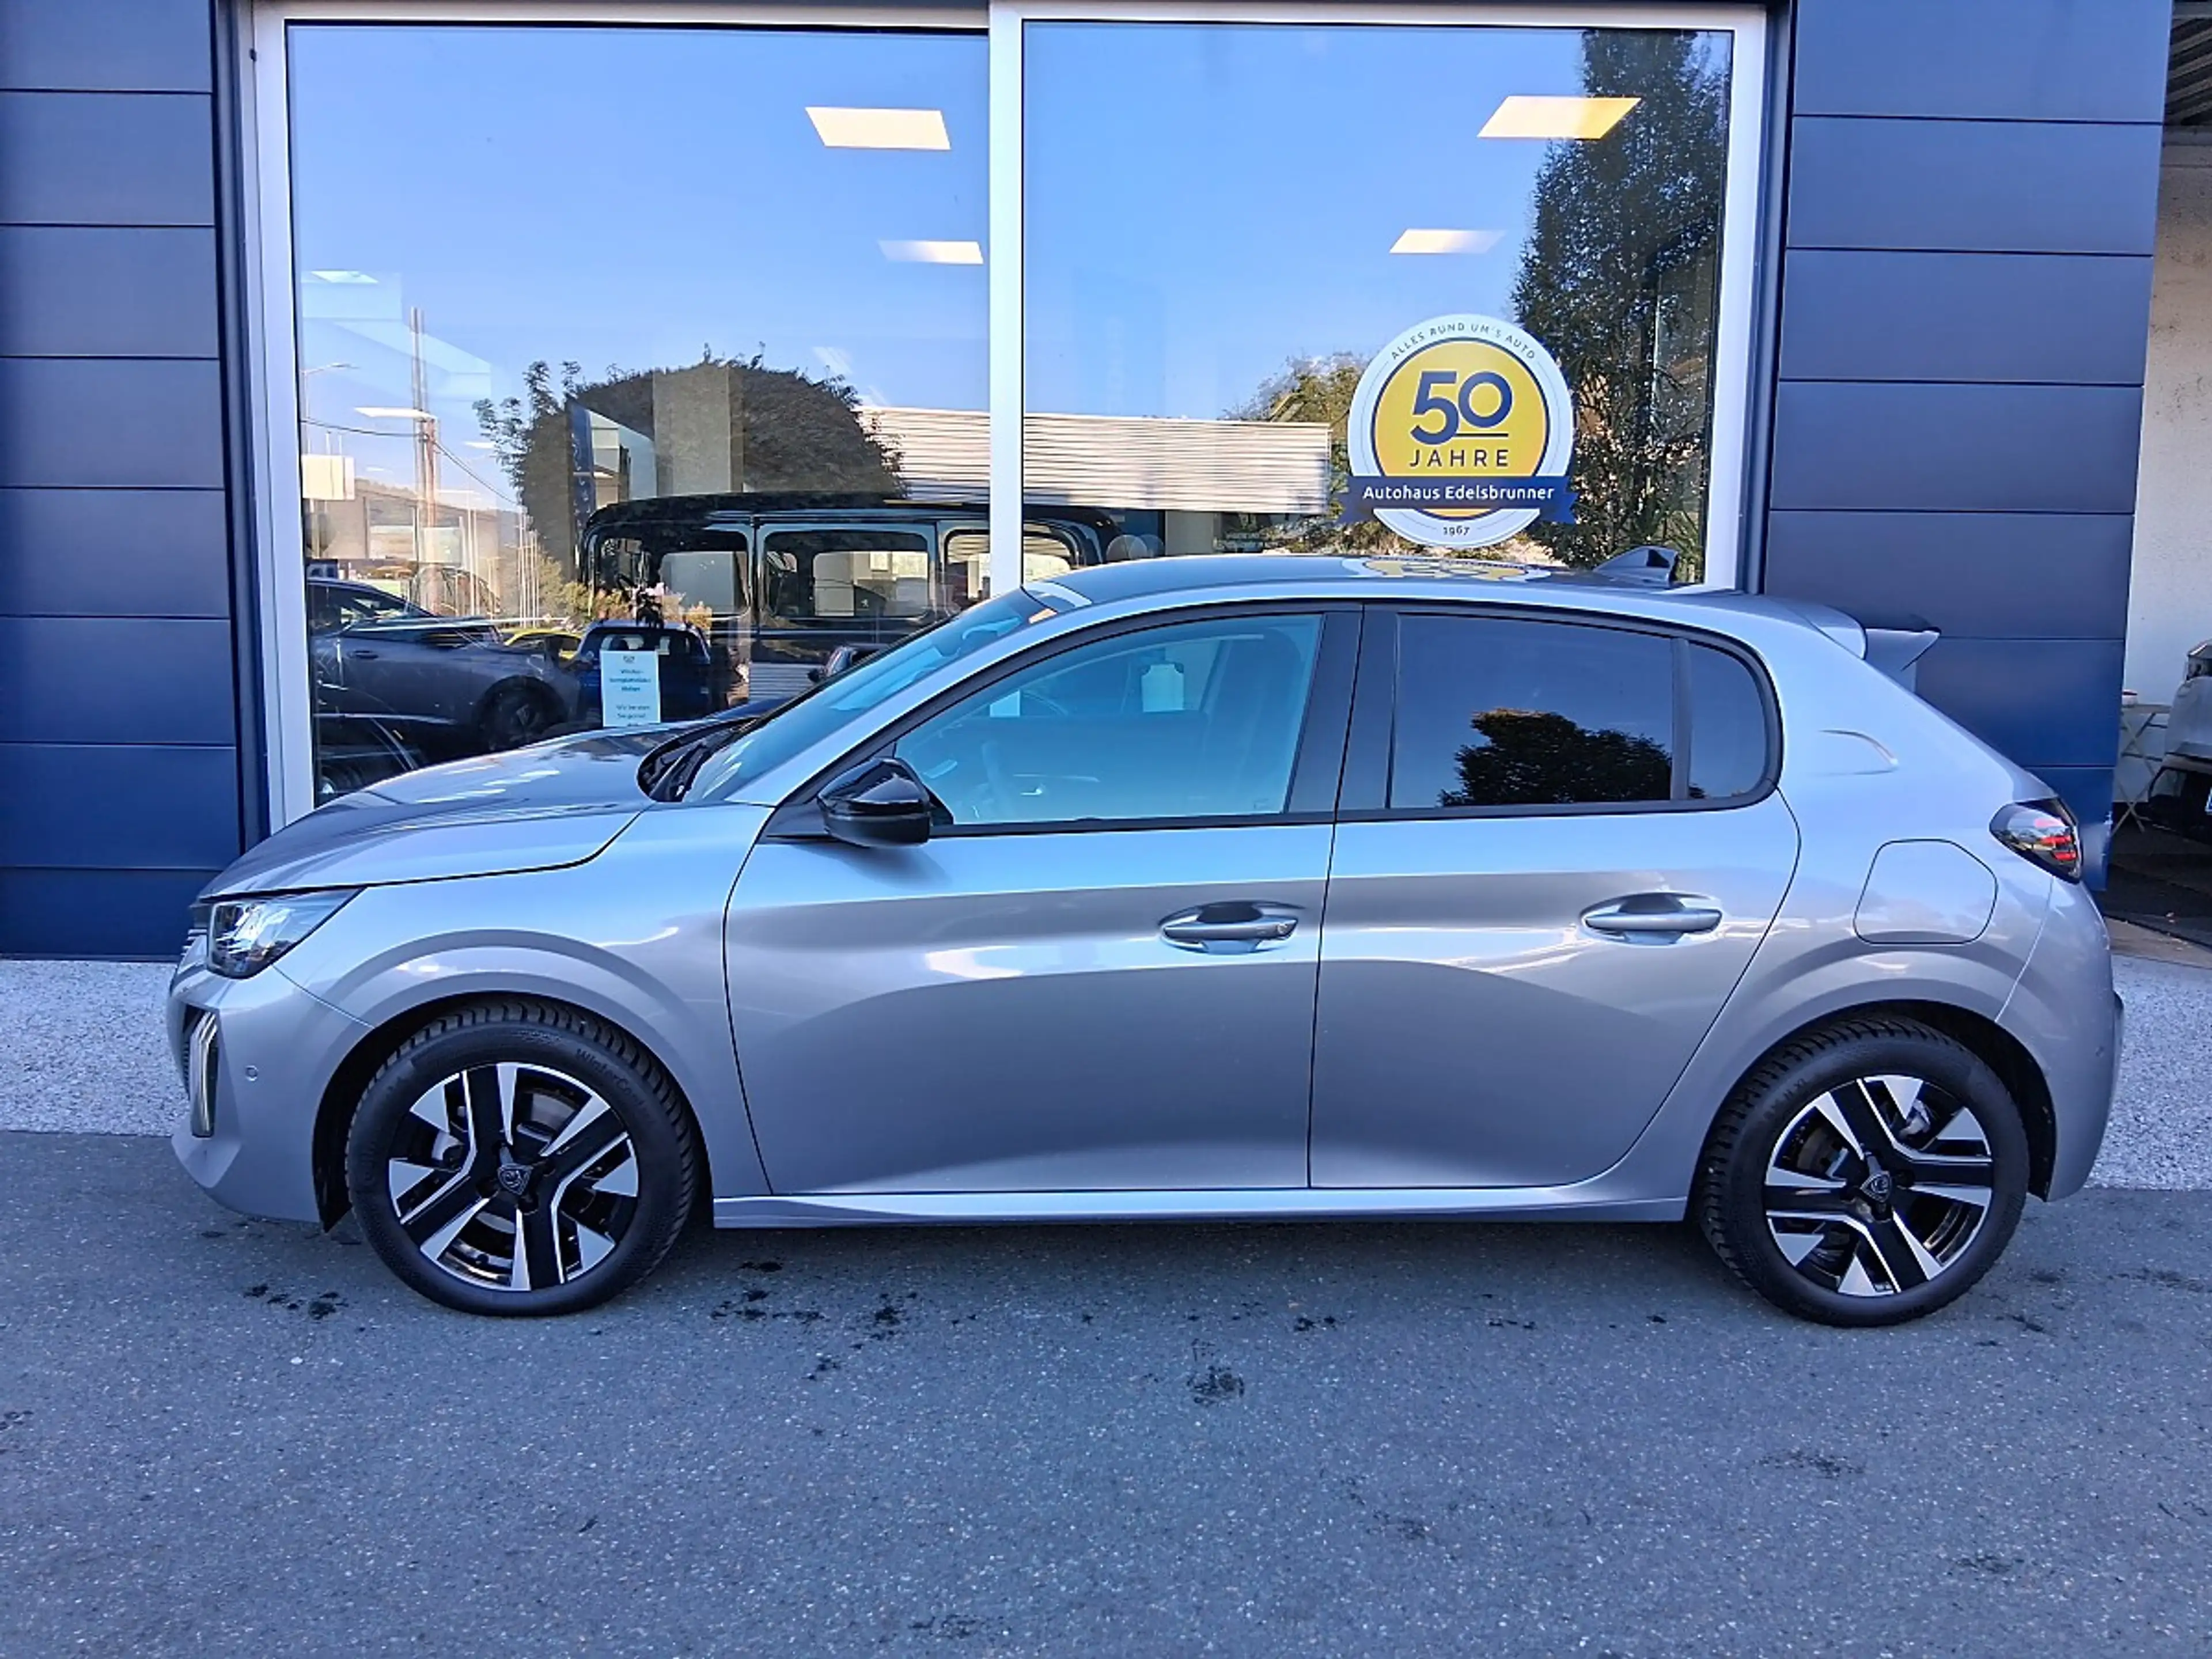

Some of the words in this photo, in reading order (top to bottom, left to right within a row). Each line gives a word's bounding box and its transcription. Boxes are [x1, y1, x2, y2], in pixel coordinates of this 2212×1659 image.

[1391, 332, 1425, 359] ALLES
[1429, 322, 1465, 336] RUND
[1505, 335, 1535, 359] AUTO
[1410, 371, 1513, 445] 50
[1409, 449, 1509, 467] JAHRE
[1362, 485, 1440, 500] Autohaus
[1445, 484, 1555, 500] Edelsbrunner
[1443, 525, 1471, 537] 1967
